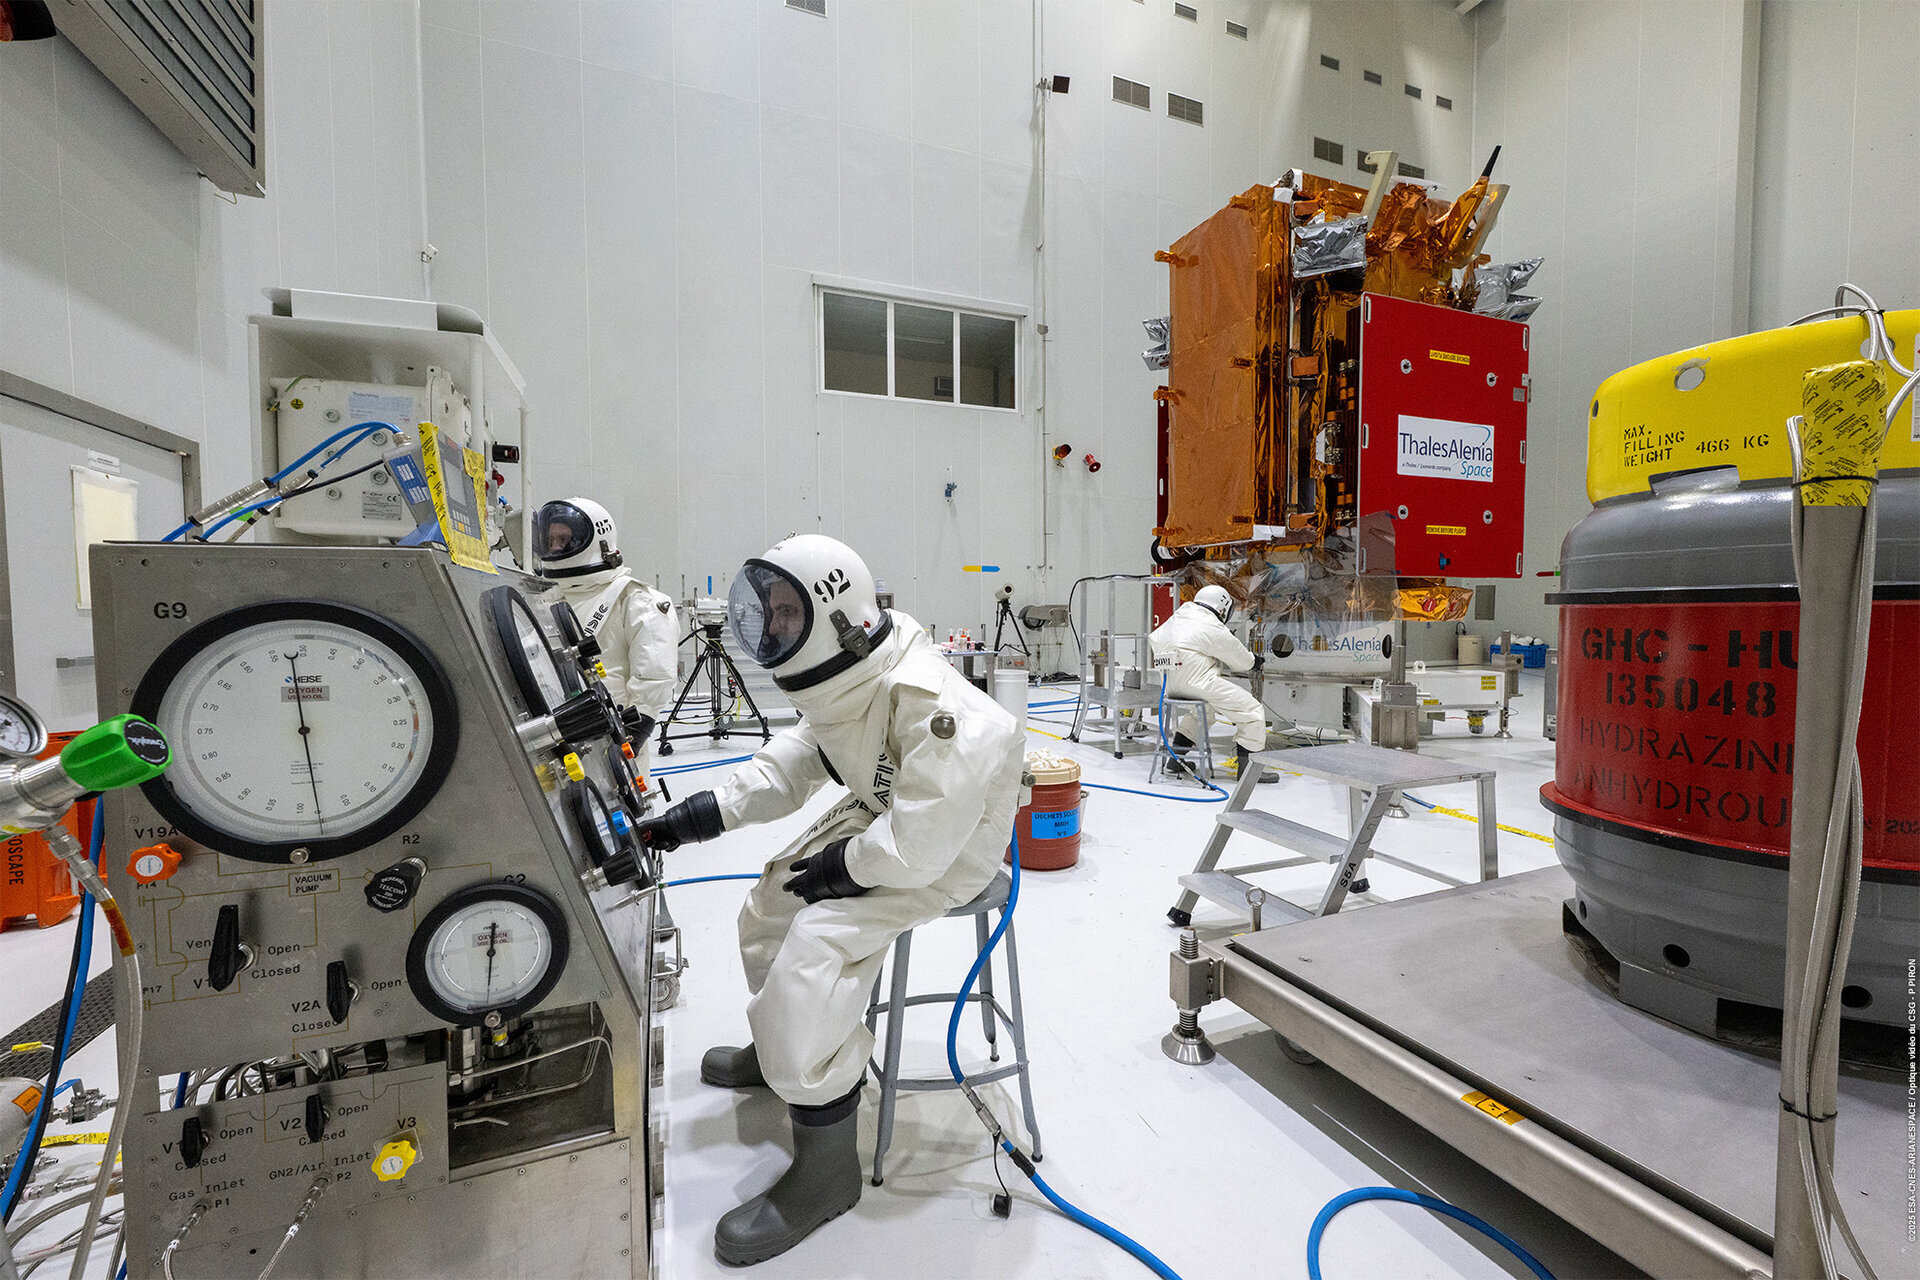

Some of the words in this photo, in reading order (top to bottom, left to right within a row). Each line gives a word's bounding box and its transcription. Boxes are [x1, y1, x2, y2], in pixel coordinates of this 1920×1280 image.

[1624, 424, 1652, 440] MAX.
[1399, 432, 1492, 462] ThalesAlenia
[1624, 431, 1685, 454] FILLING
[1624, 448, 1673, 467] WEIGHT
[1696, 438, 1730, 454] 466
[1743, 434, 1770, 449] KG
[1461, 460, 1492, 478] Space
[596, 519, 613, 535] 85
[814, 569, 851, 603] 92
[153, 602, 187, 619] G9
[584, 603, 609, 637] ISEC
[299, 645, 307, 658] 0.50
[1581, 628, 1669, 663] GHC
[268, 650, 279, 663] 0.55
[328, 648, 338, 661] 0.45
[1353, 651, 1380, 666] Space
[240, 661, 254, 674] 0.60
[353, 658, 365, 671] 0.40
[217, 679, 232, 691] 0.65
[294, 675, 322, 683] HEISE
[374, 675, 387, 686] 0.35
[288, 687, 322, 695] OXYGEN
[1606, 672, 1777, 718] 135048
[387, 695, 401, 705] 0.30
[202, 702, 219, 712] 0.70
[391, 741, 405, 750] 0.20
[1580, 717, 1794, 775] HYDRAZIN
[202, 751, 218, 761] 0.80
[382, 763, 395, 774] 0.15
[216, 772, 232, 783] 0.85
[364, 781, 377, 793] 0.10
[237, 788, 251, 801] 0.90
[340, 794, 352, 807] 0.05
[1575, 761, 1787, 828] ANHYDROU
[265, 798, 277, 812] 0.95
[135, 827, 178, 838] V19A
[402, 834, 420, 845] R2
[8, 833, 24, 885] OSCAPE
[295, 873, 332, 884] VACUUM
[504, 874, 526, 885] G2
[1340, 862, 1356, 887] S5A
[295, 884, 319, 893] PUMP
[380, 884, 404, 895] TESCOM
[477, 932, 508, 941] OXYGEN
[185, 939, 214, 949] Ven
[267, 943, 301, 956] Open
[251, 964, 301, 979] Closed
[142, 985, 162, 994] P17
[371, 978, 402, 991] Open
[291, 1000, 321, 1014] V2A
[338, 1103, 369, 1117] Open
[280, 1117, 301, 1131] V2
[397, 1116, 417, 1129] V3
[219, 1126, 254, 1140] Open
[298, 1128, 347, 1147] Csed
[174, 1153, 226, 1172] Csed
[268, 1162, 326, 1181] GN2/Air
[333, 1151, 371, 1167] Inlet
[336, 1171, 352, 1183] P2
[168, 1189, 195, 1202] Gas
[204, 1178, 246, 1194] Inlet
[215, 1198, 230, 1209] P1
